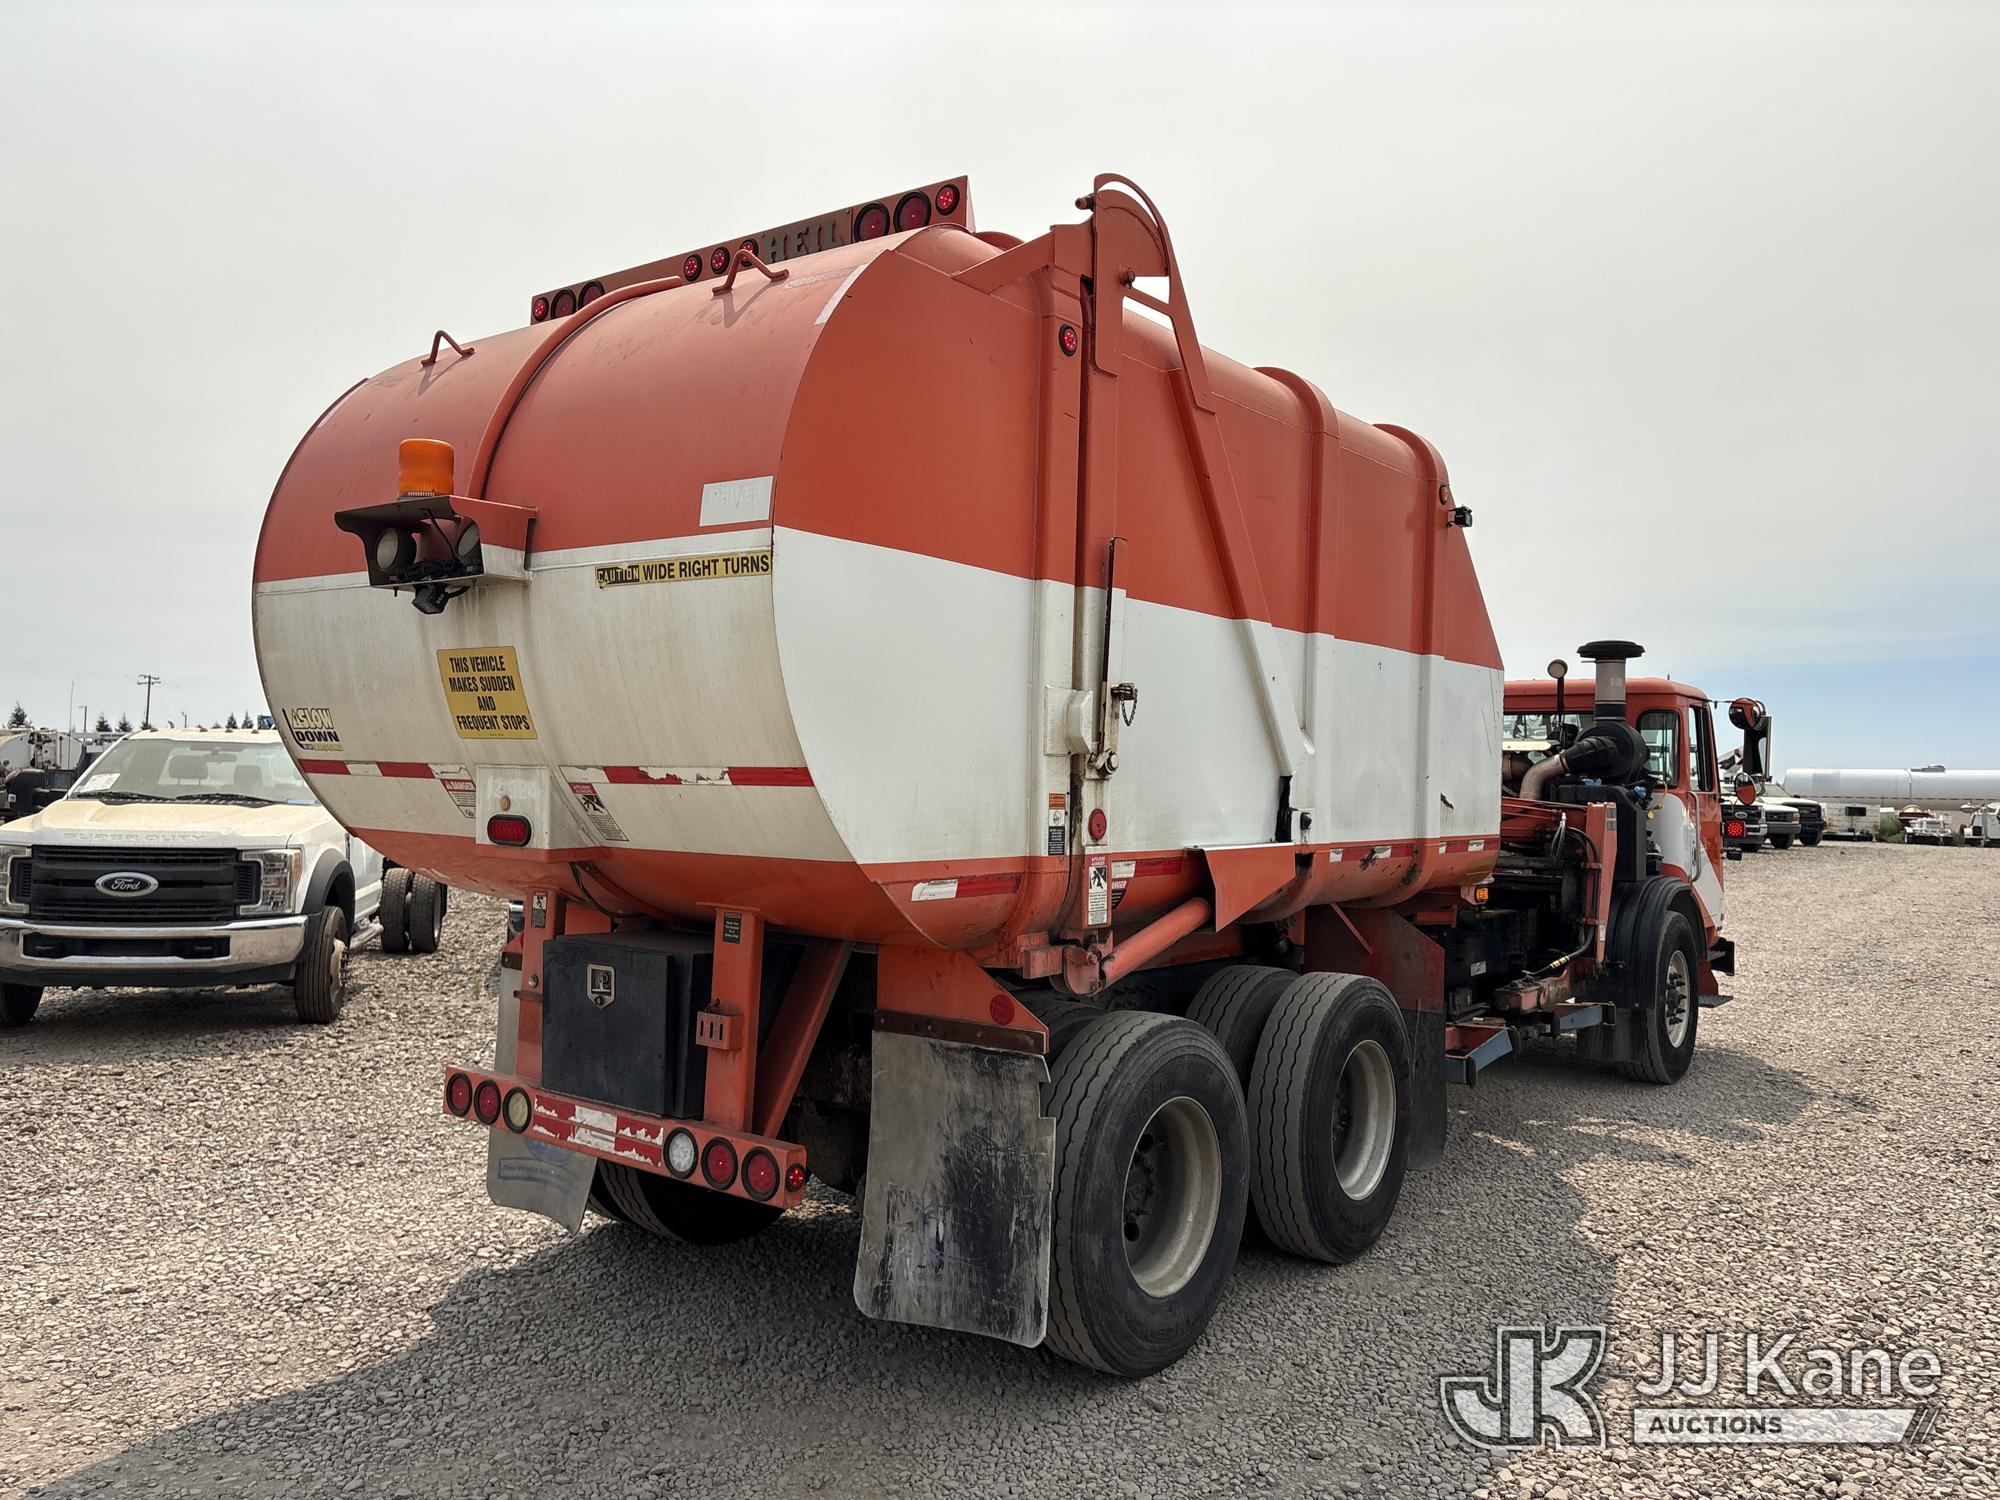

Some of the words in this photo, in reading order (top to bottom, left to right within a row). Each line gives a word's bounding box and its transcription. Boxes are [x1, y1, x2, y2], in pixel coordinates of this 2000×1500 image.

[762, 221, 845, 264] HEIL
[643, 564, 676, 581] WIDE
[679, 558, 720, 578] RIGHT
[722, 554, 770, 574] TURNS
[449, 656, 469, 673] THIS
[469, 655, 506, 672] VEHICLE
[448, 676, 479, 693] MAKES
[479, 675, 516, 692] SUDDEN
[477, 695, 497, 711] AND
[296, 707, 334, 729] SLOW
[456, 715, 501, 731] FREQUENT
[500, 714, 530, 730] STOPS
[294, 730, 340, 742] DOWN
[111, 877, 141, 891] Ford
